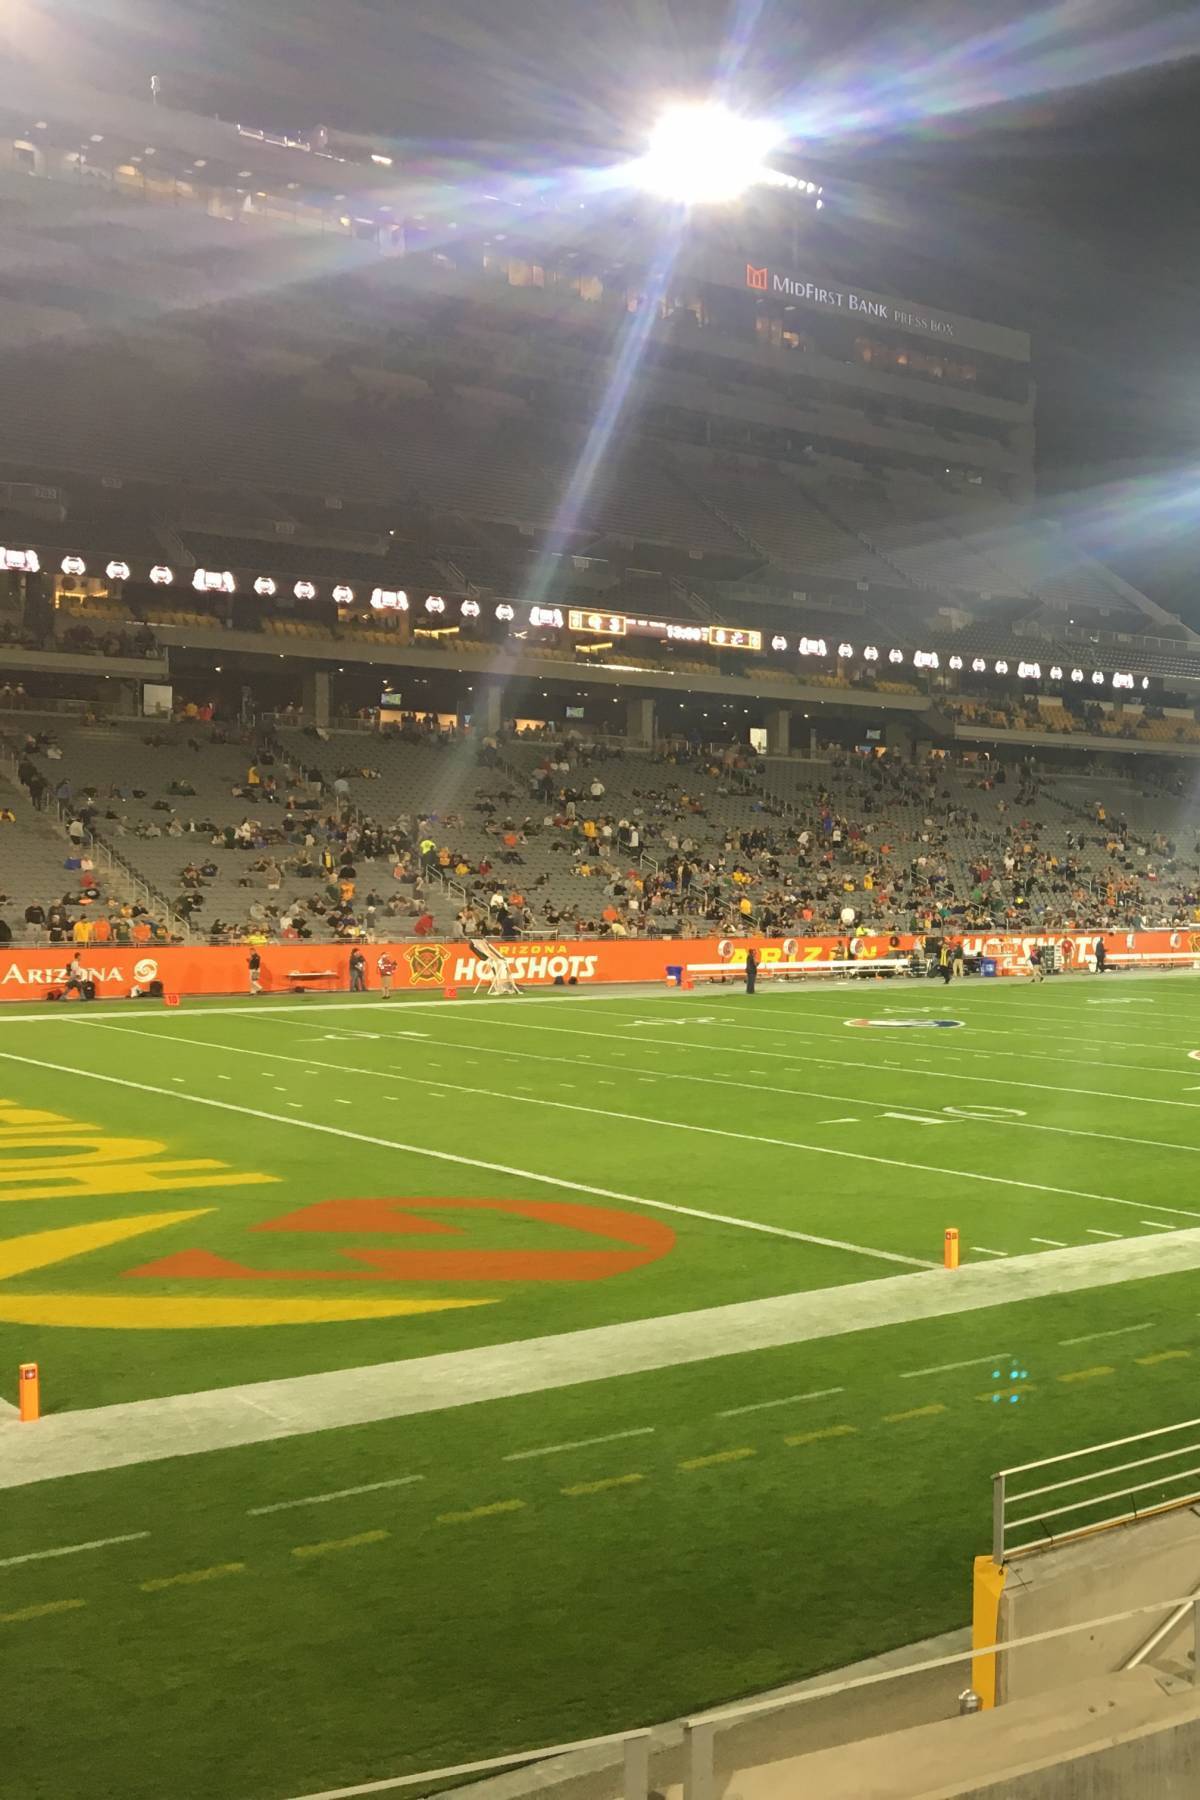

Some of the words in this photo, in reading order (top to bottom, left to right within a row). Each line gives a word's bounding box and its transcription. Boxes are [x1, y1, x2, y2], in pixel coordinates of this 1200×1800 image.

[848, 294, 888, 319] BANK
[497, 943, 567, 955] RIZONA
[454, 955, 598, 981] HOSHOTS
